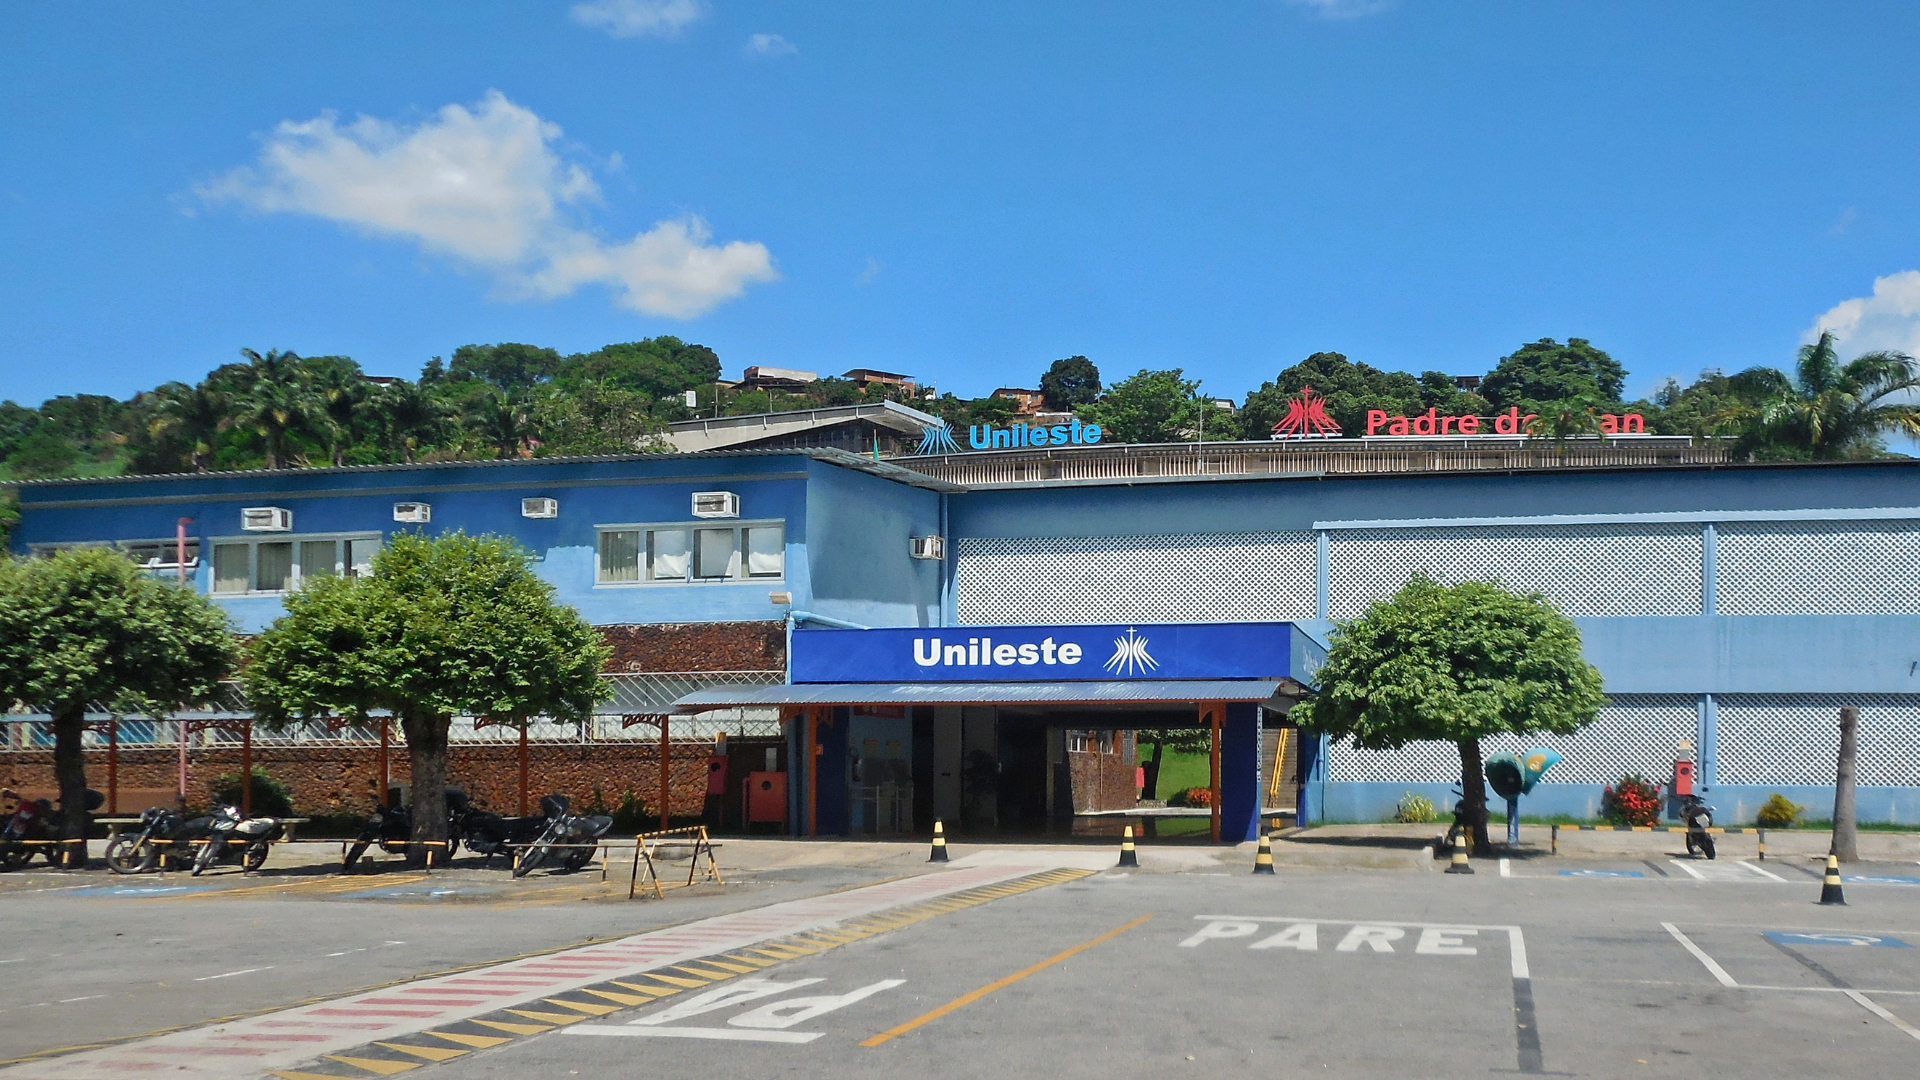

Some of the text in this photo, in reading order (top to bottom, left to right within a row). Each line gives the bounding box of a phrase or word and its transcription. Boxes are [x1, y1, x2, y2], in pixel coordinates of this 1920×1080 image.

[969, 419, 1102, 449] Unileste
[1366, 407, 1479, 436] Padre
[1588, 407, 1645, 434] an
[913, 637, 1083, 666] Unileste
[1177, 920, 1478, 955] PARE
